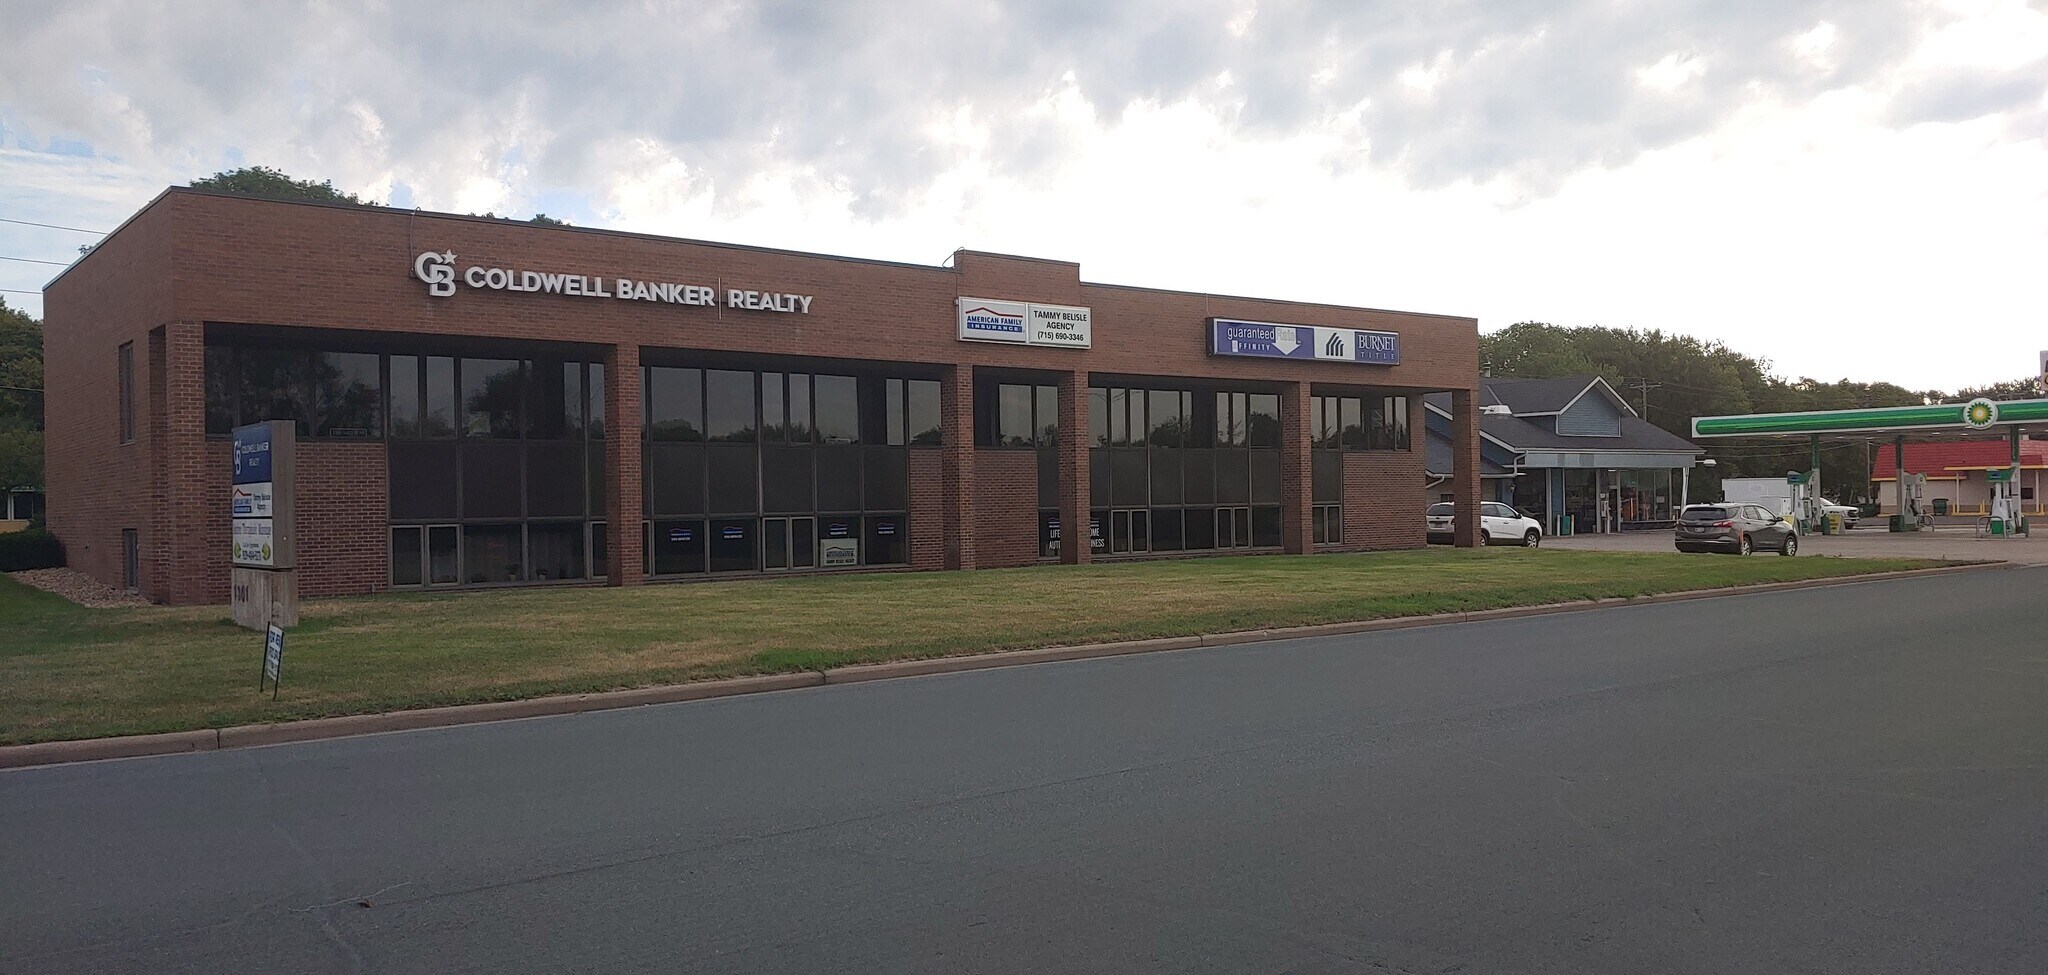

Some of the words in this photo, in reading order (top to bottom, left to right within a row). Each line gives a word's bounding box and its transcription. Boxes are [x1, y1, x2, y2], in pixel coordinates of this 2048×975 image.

[464, 266, 612, 298] COLDWELL
[616, 278, 716, 307] BANKER
[728, 289, 814, 314] REALTY
[966, 315, 999, 324] AMERICAN
[1000, 318, 1023, 326] FAMILY
[1033, 310, 1061, 320] TAMMY
[1062, 313, 1088, 322] BELISLE
[970, 323, 1019, 332] INSURANCE
[1046, 321, 1075, 331] AGENCY
[1037, 331, 1054, 340] (715)
[1055, 331, 1084, 341] 690-3346
[1227, 327, 1275, 341] guaranteed
[1358, 334, 1396, 352] BURNET
[1360, 351, 1396, 360] TITLE
[1090, 527, 1100, 537] OME
[1049, 540, 1060, 550] AUT
